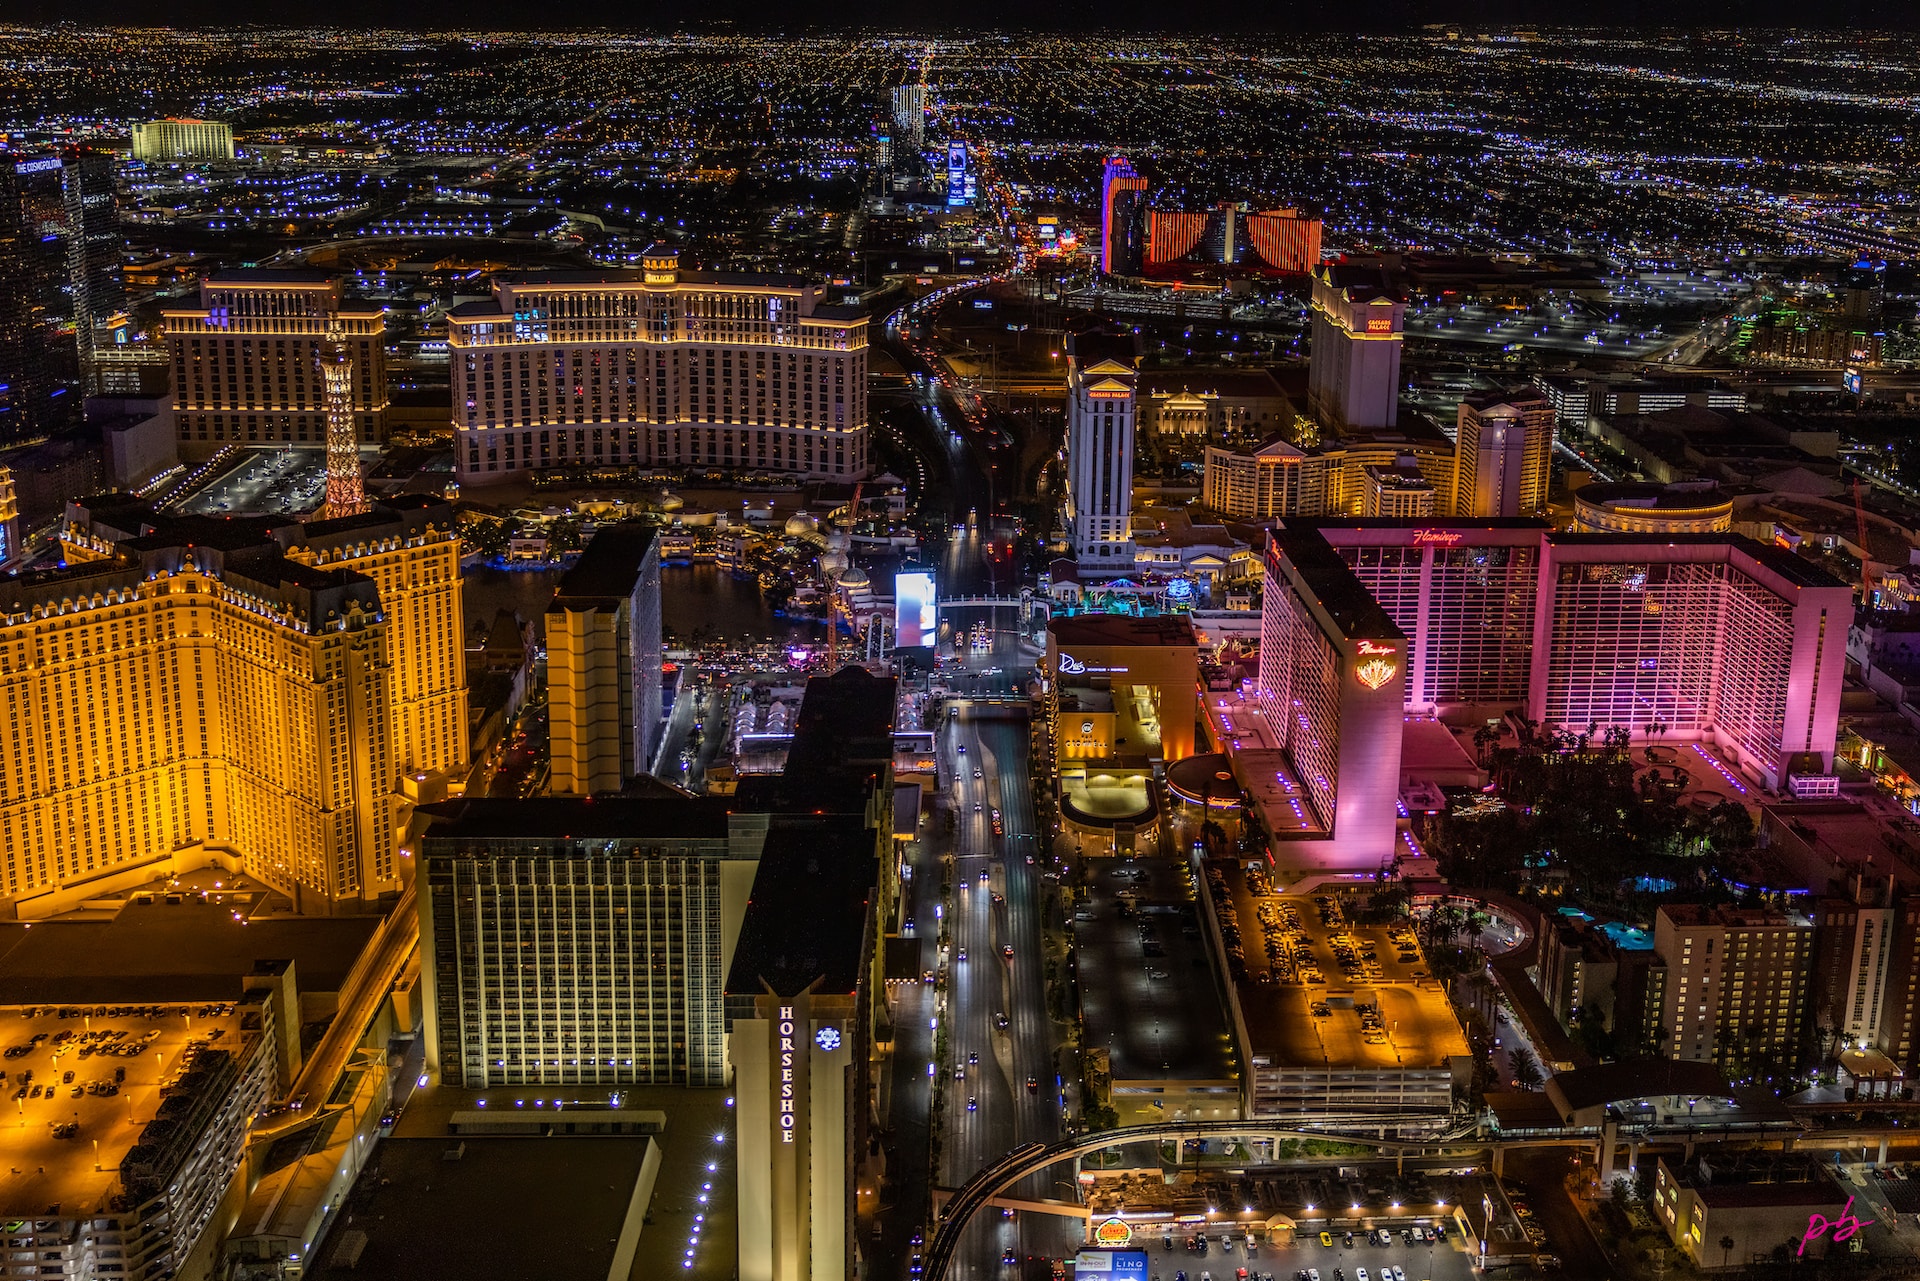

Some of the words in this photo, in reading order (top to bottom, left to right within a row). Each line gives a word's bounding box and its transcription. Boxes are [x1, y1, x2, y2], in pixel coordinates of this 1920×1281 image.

[16, 163, 27, 173] THE
[27, 159, 62, 172] COSMOPOLITAN
[1413, 529, 1462, 545] Flamingo
[1357, 640, 1396, 656] Flamingo
[779, 1006, 795, 1143] HORSESHOE
